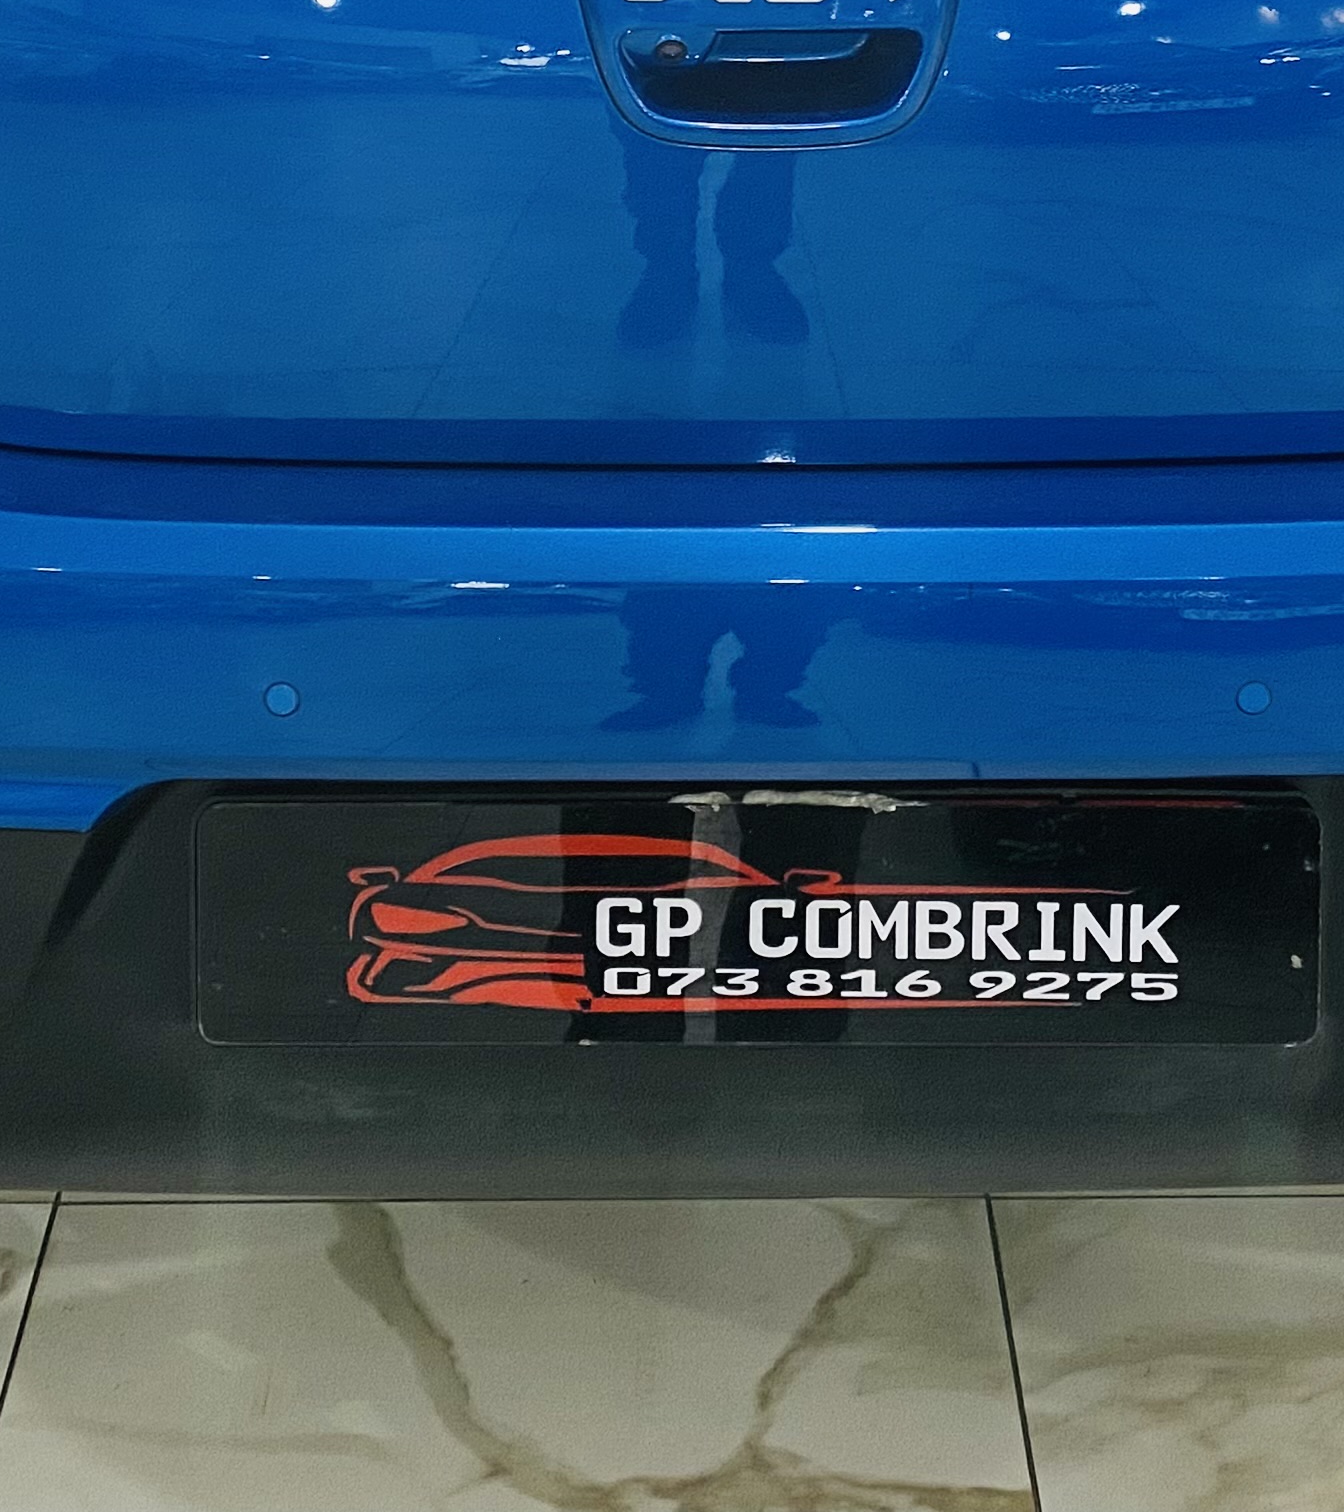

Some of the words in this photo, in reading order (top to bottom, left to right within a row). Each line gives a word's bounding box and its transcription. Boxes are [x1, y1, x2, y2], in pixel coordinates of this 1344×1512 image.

[595, 897, 703, 957] GP
[748, 899, 1181, 964] COMBRINK
[603, 967, 760, 996] 073
[786, 969, 942, 998] 816
[968, 970, 1179, 1001] 9275
